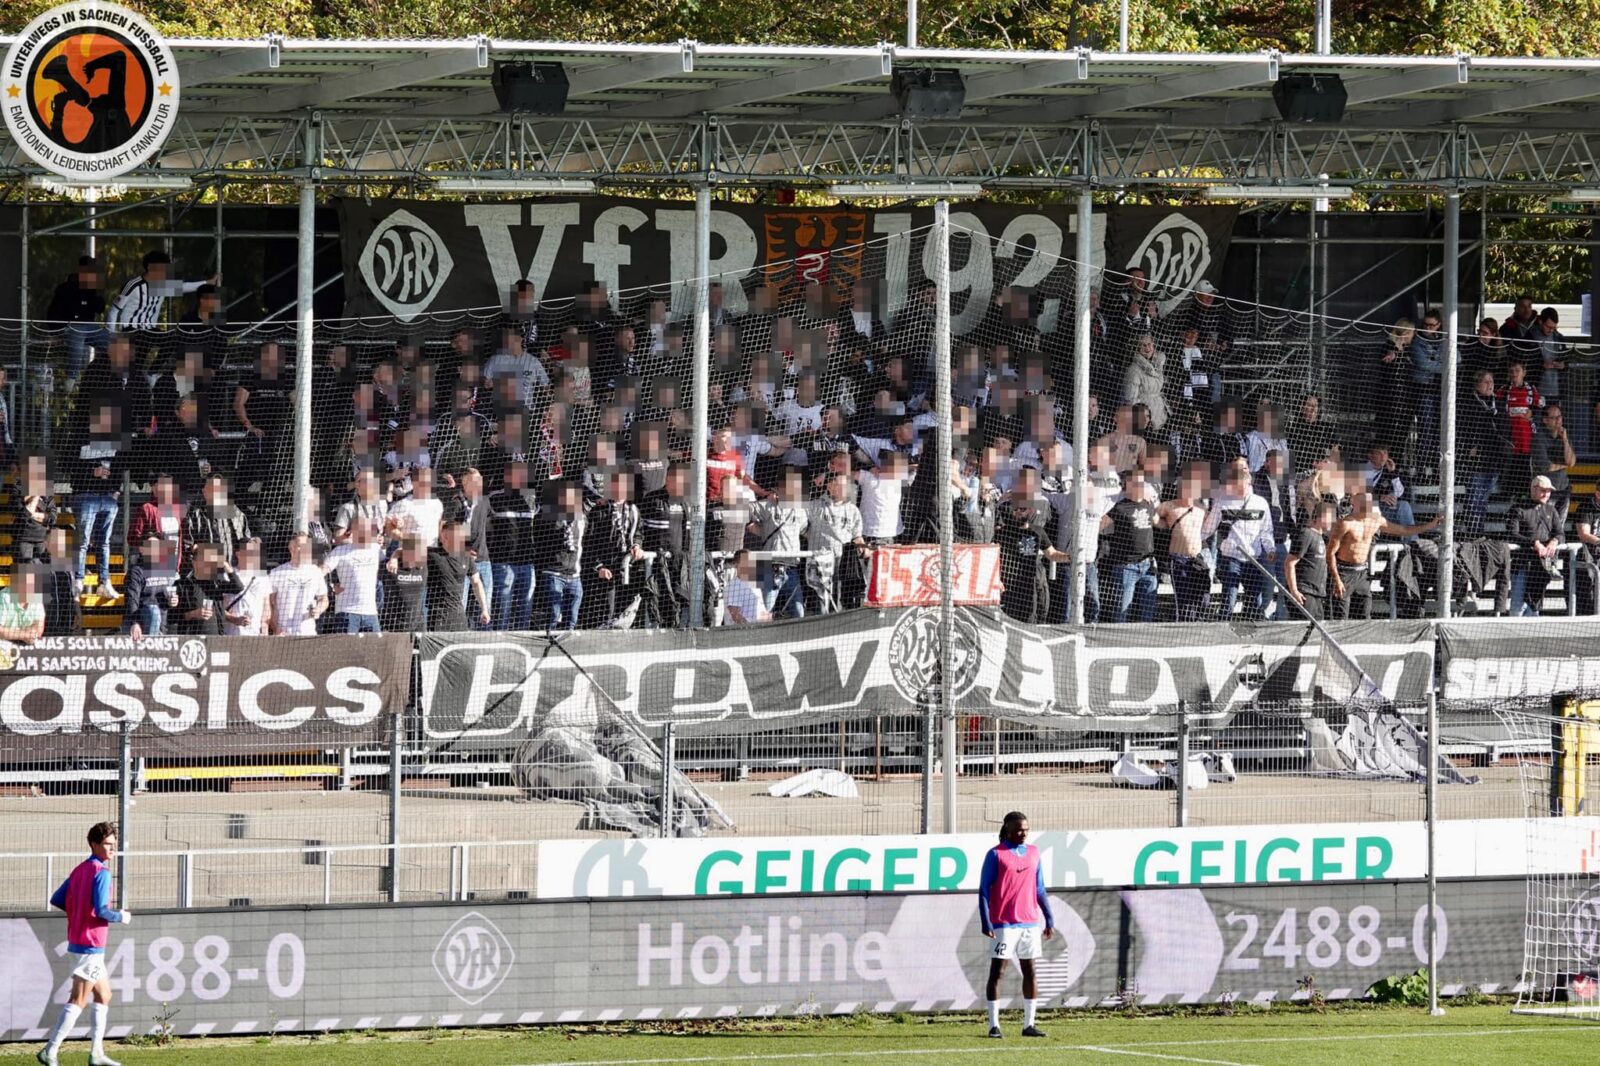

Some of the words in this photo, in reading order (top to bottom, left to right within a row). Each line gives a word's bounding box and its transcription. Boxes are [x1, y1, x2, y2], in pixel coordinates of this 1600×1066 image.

[464, 203, 759, 321] VfR
[16, 656, 38, 671] AM
[41, 656, 106, 671] SAMSTAG
[68, 637, 103, 650] SOLL
[104, 637, 134, 651] MAN
[138, 637, 179, 650] SONST
[695, 847, 968, 896] GEIGER
[1133, 836, 1394, 885] GEIGER
[637, 915, 889, 987] Hotline
[1224, 904, 1449, 970] 2488-0
